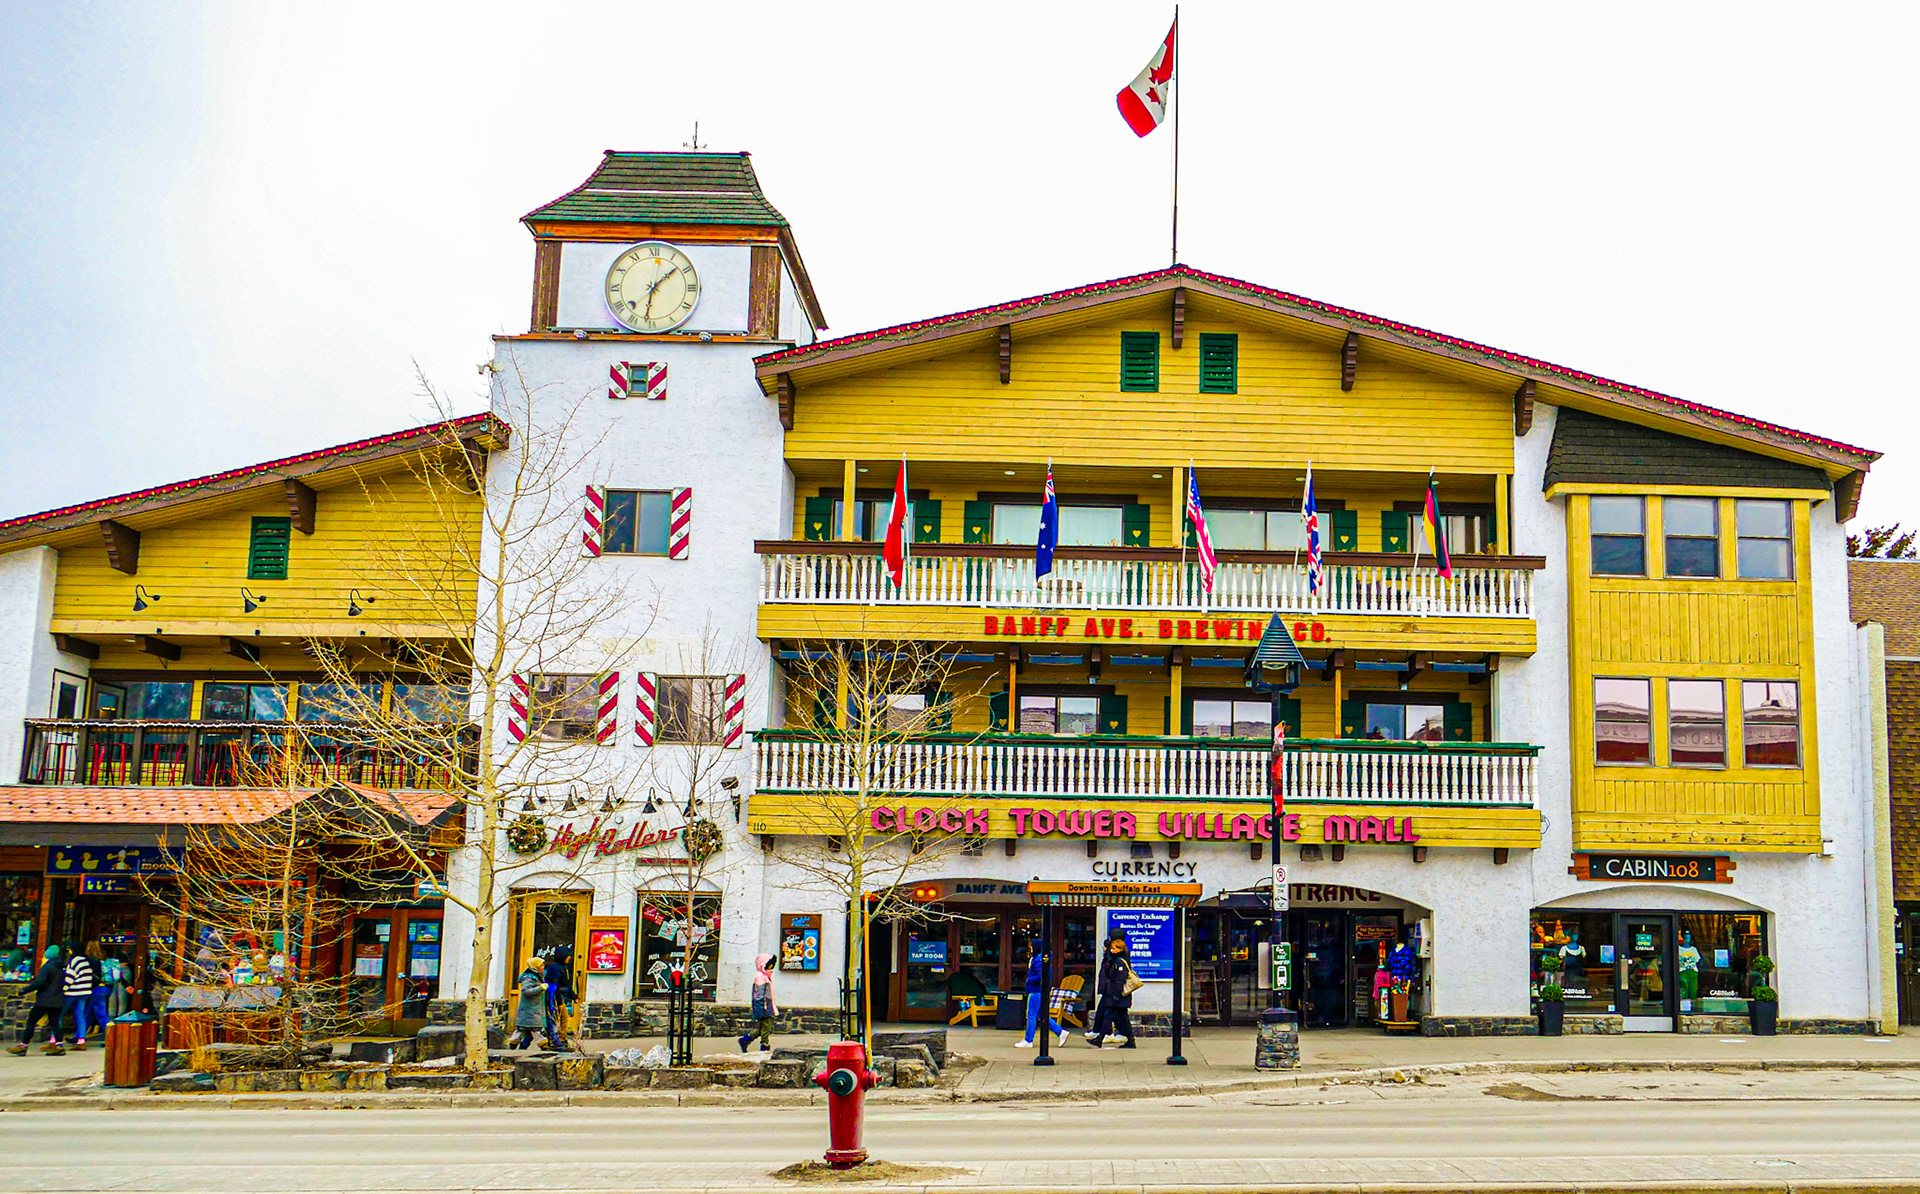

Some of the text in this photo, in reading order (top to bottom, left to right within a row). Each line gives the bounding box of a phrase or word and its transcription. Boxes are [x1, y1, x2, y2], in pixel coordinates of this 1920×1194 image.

[984, 615, 1332, 643] BANFF AVE. BREWIN CO.
[752, 822, 767, 832] 110
[870, 806, 1420, 843] CLOCK TOWER VILLAGE MALL
[549, 816, 687, 860] High Rollers
[1092, 861, 1198, 876] CURRENCY
[1606, 859, 1699, 878] CABIN108
[956, 883, 1024, 895] BANFF AVE
[1068, 884, 1161, 893] Downtown Buffalo East
[1264, 884, 1381, 903] TRANCE
[1112, 913, 1170, 922] Currency Exchange
